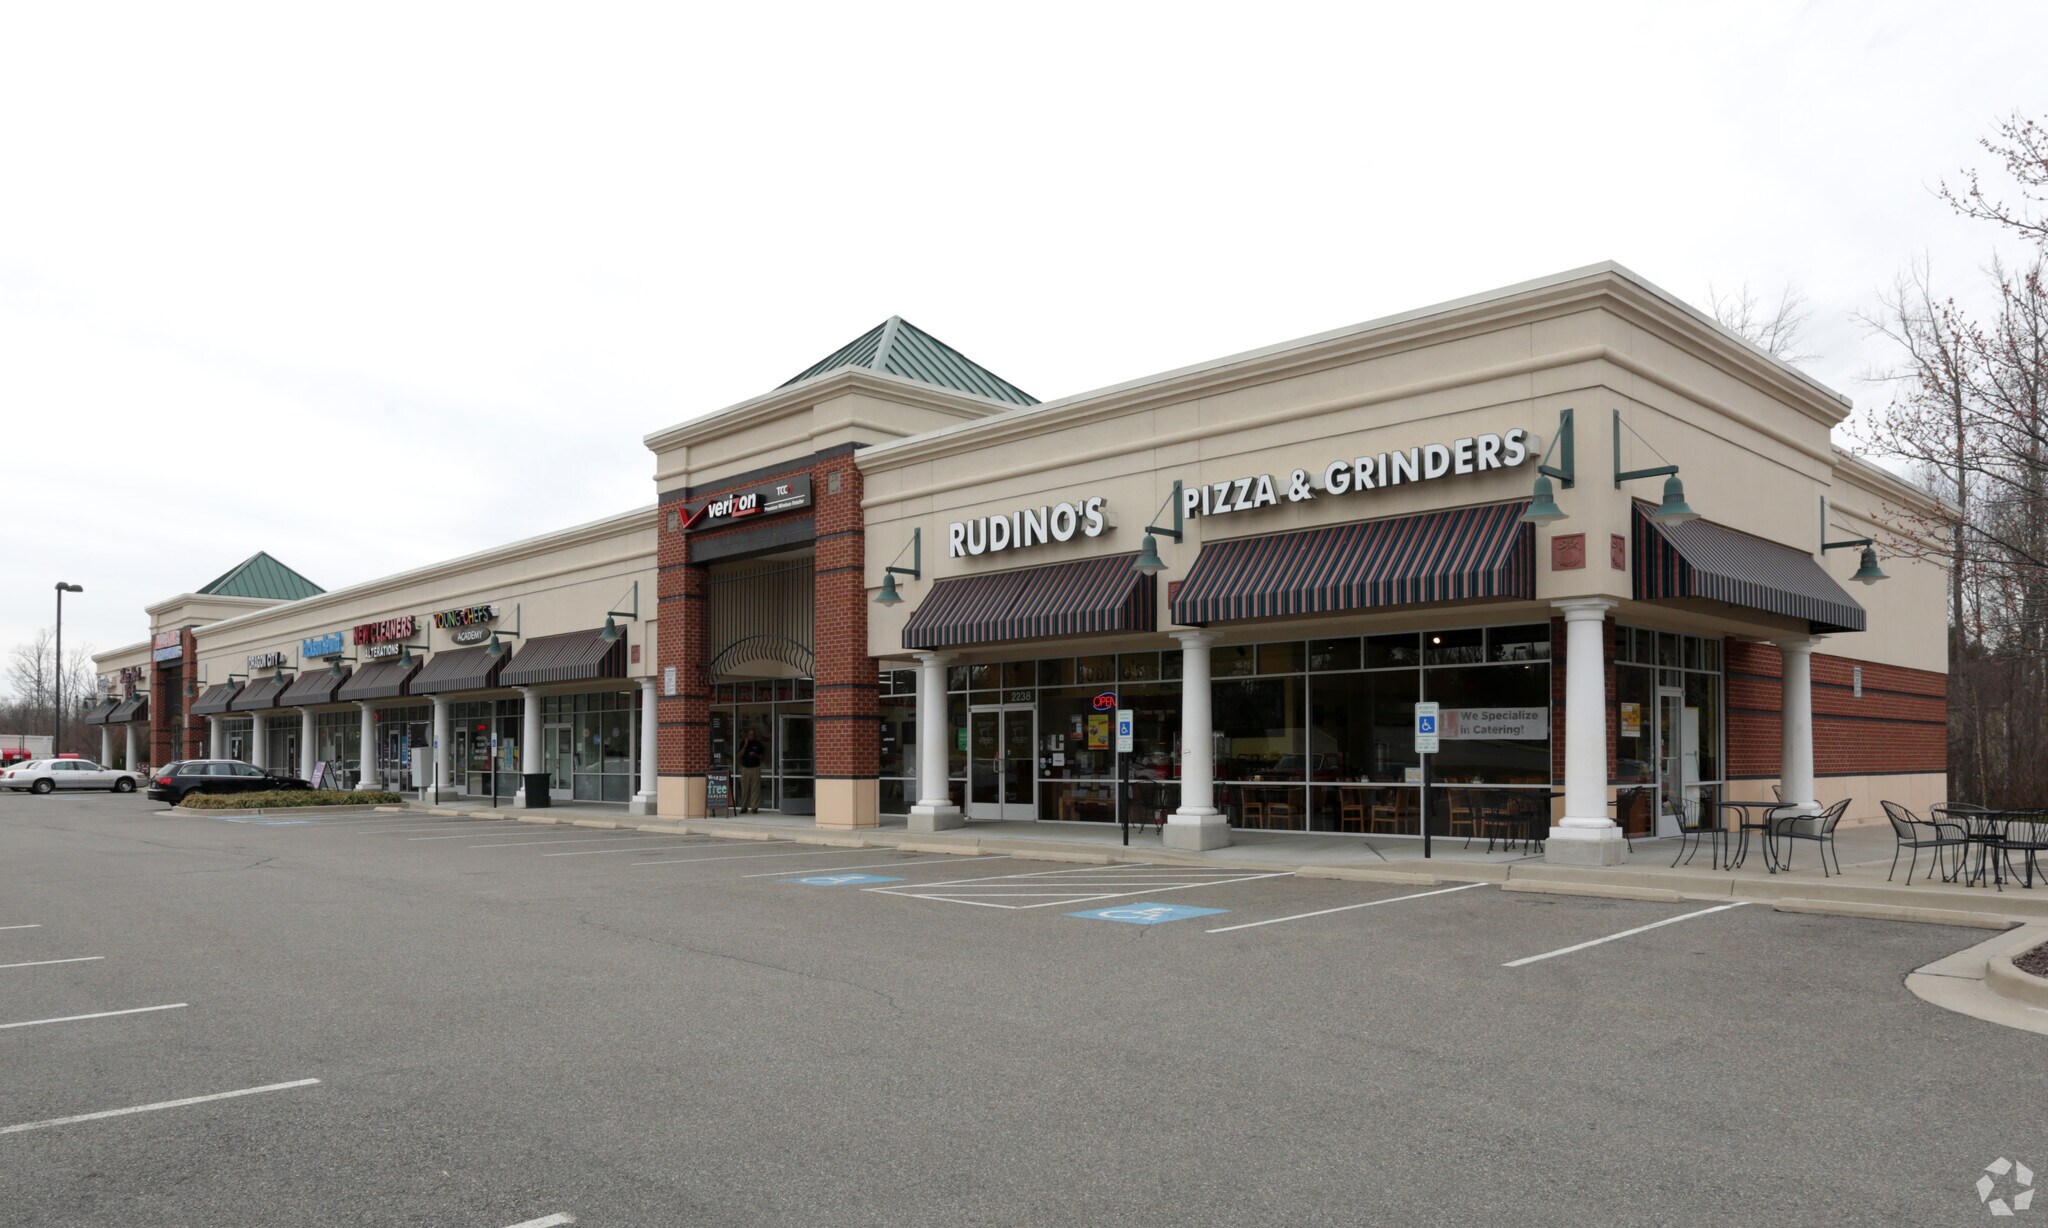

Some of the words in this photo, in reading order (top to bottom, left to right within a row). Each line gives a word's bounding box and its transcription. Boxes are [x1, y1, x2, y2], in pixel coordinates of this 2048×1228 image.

[1183, 473, 1278, 520] PIZZA
[1287, 468, 1314, 502] &
[1323, 427, 1528, 496] GRINDERS
[776, 484, 789, 496] TCC
[707, 492, 758, 518] verizon
[948, 496, 1109, 560] RUDINO'S
[433, 609, 461, 629] YOUNG
[463, 605, 489, 625] CHEFS
[353, 624, 370, 646] NEW
[371, 615, 413, 643] CLEANERS
[457, 629, 483, 642] ACADEMY
[364, 643, 400, 659] ALTERATIONS
[1011, 691, 1032, 702] 2238
[1093, 695, 1118, 707] OPEN
[1461, 711, 1479, 721] We
[1481, 710, 1539, 722] Specialize
[1460, 725, 1470, 735] in
[1473, 724, 1525, 736] Catering!
[707, 780, 728, 794] free
